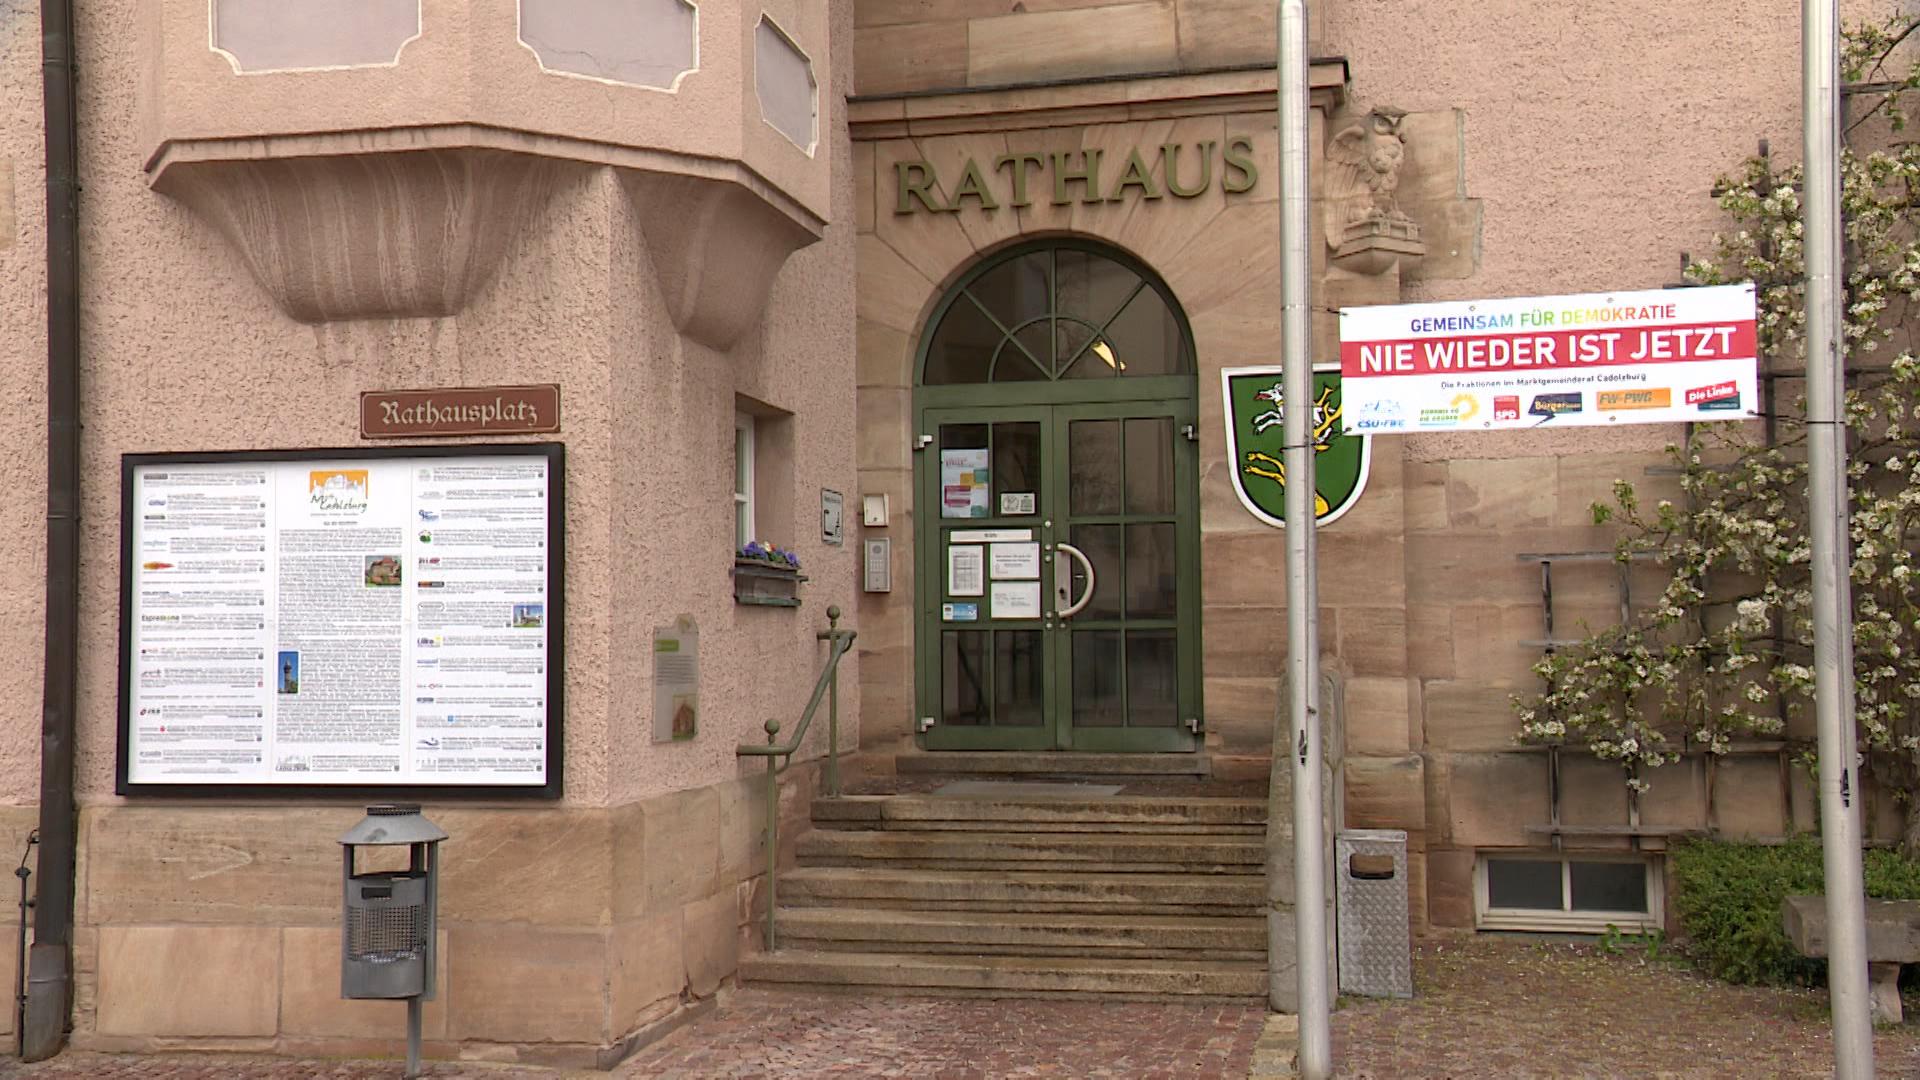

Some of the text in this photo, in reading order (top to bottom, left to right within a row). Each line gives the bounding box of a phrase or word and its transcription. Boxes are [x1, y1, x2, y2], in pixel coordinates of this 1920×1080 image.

[894, 135, 1258, 216] RATHAUS
[1411, 303, 1677, 332] GEMEINSAM FÜR DEMOKRATIE
[1360, 326, 1737, 373] NIE WIEDER IST JETZT
[1441, 381, 1454, 389] Die
[1457, 380, 1501, 388] Fraktionen
[1597, 373, 1647, 383] Cadolzburg
[379, 397, 538, 428] Rathausplatz
[1495, 409, 1517, 420] SPD
